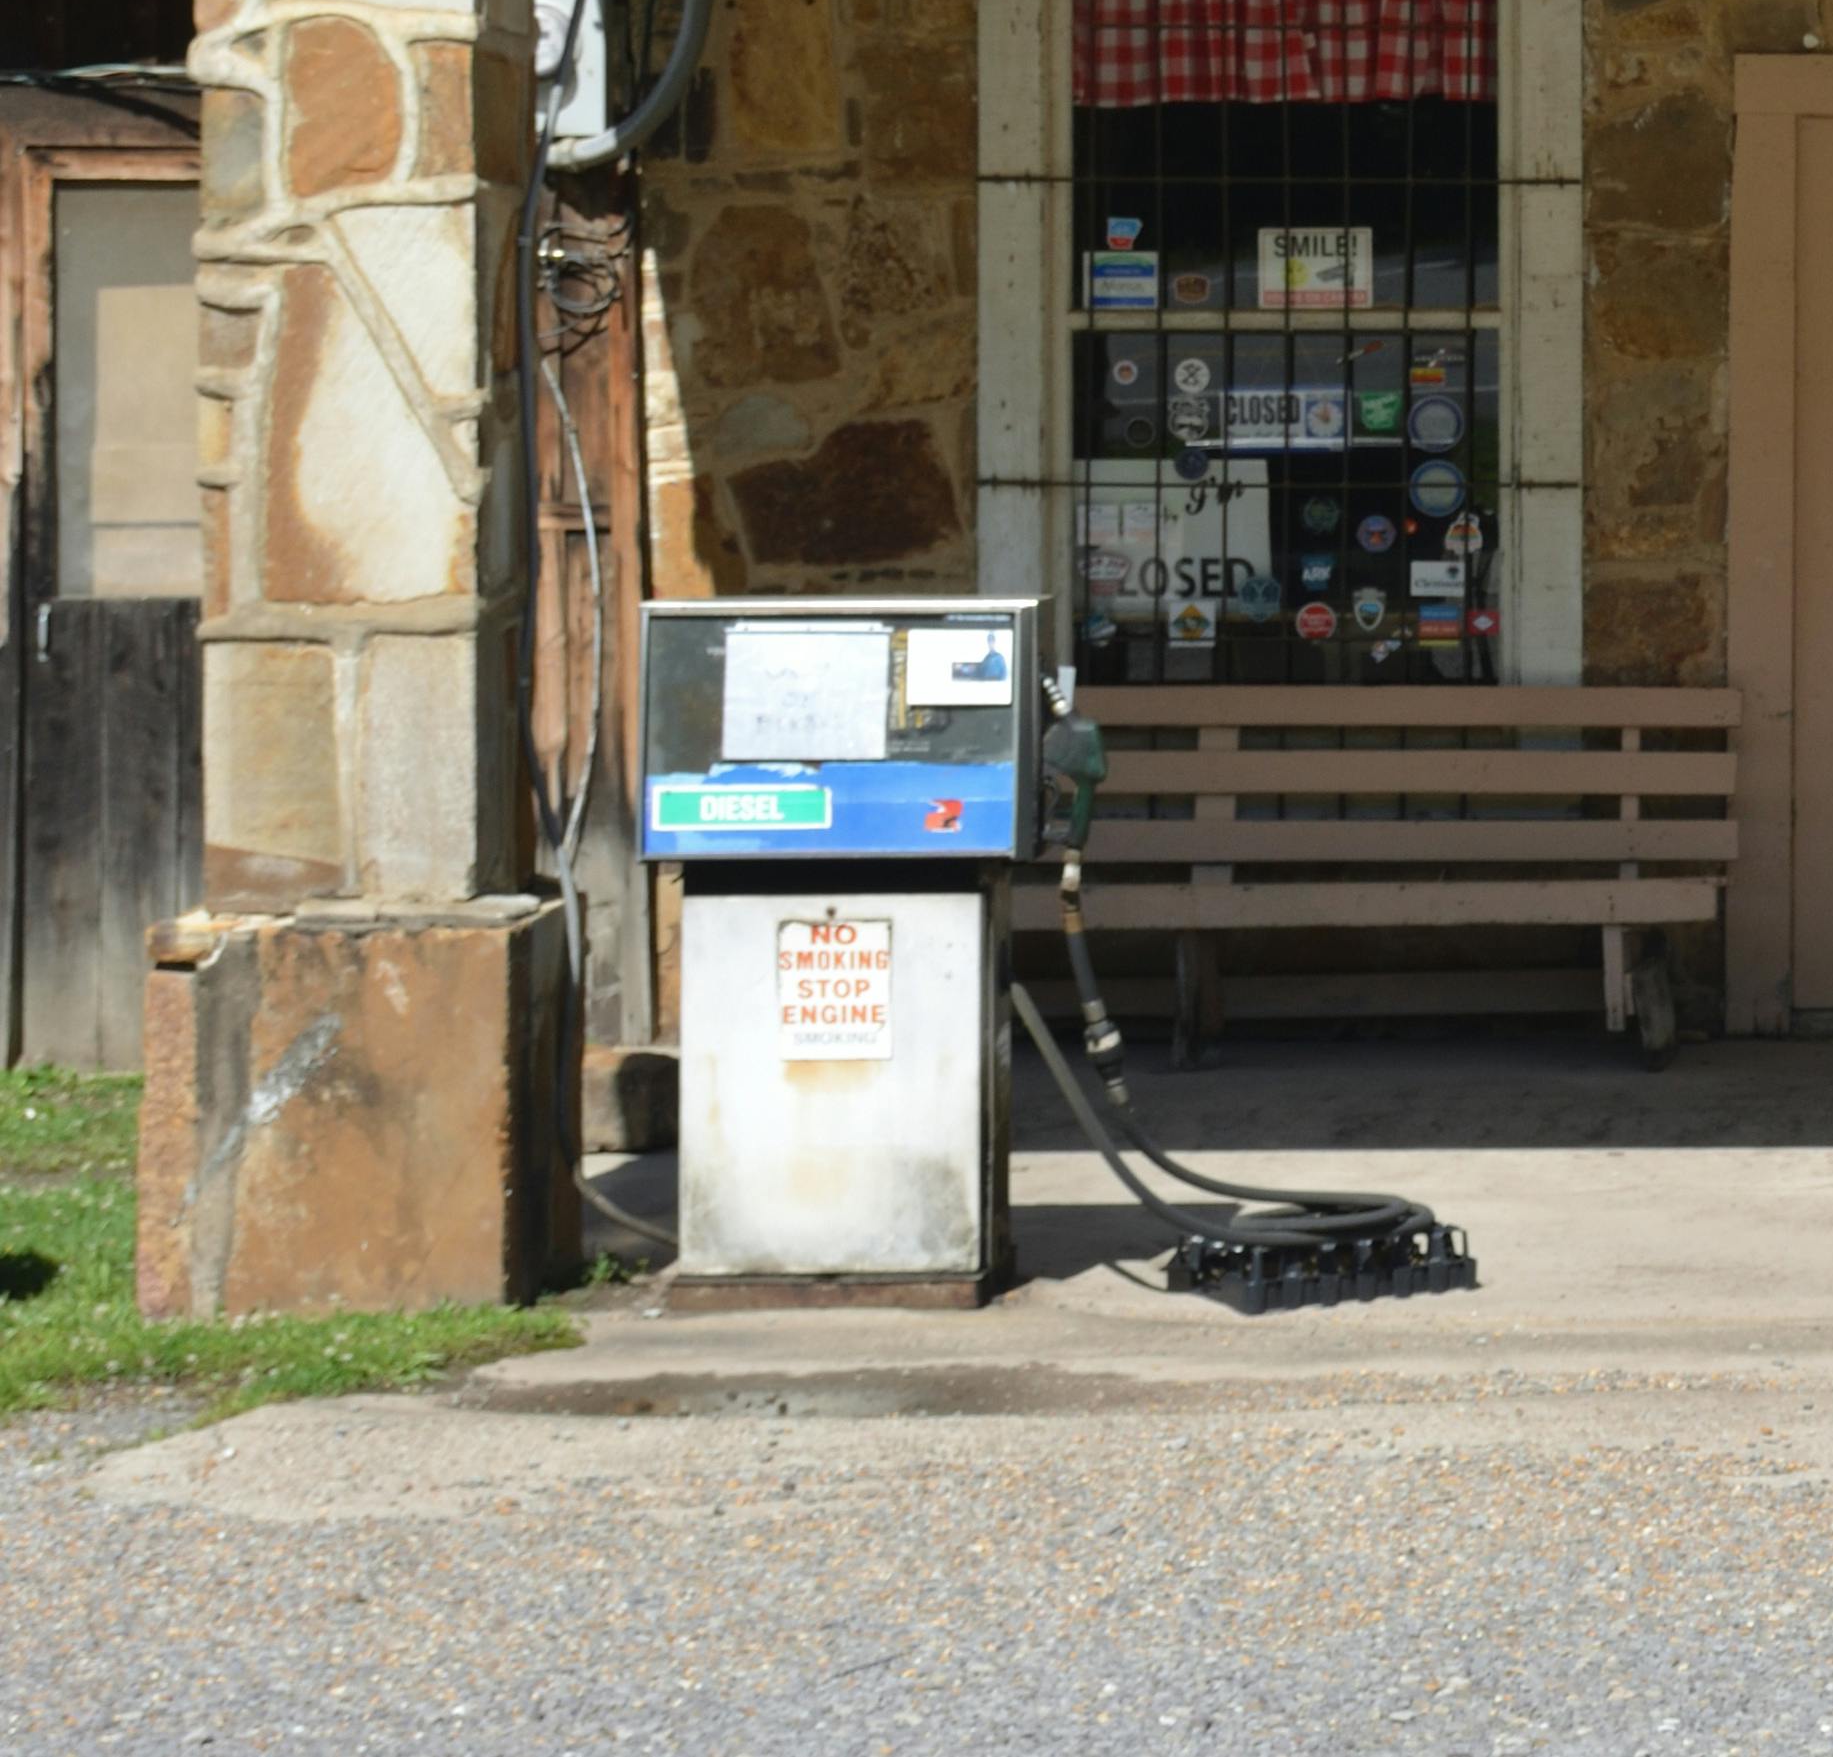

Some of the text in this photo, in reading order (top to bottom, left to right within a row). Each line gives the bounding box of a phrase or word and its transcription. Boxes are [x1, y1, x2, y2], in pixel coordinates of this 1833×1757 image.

[1273, 235, 1358, 258] SMILE!
[1227, 395, 1301, 426] CLOSED
[699, 794, 787, 823] DIESEL
[810, 922, 857, 946] NO
[778, 950, 891, 971] SMOKING
[798, 979, 870, 998] STOP
[782, 1005, 887, 1025] ENGINE
[793, 1032, 877, 1047] SMOKING
